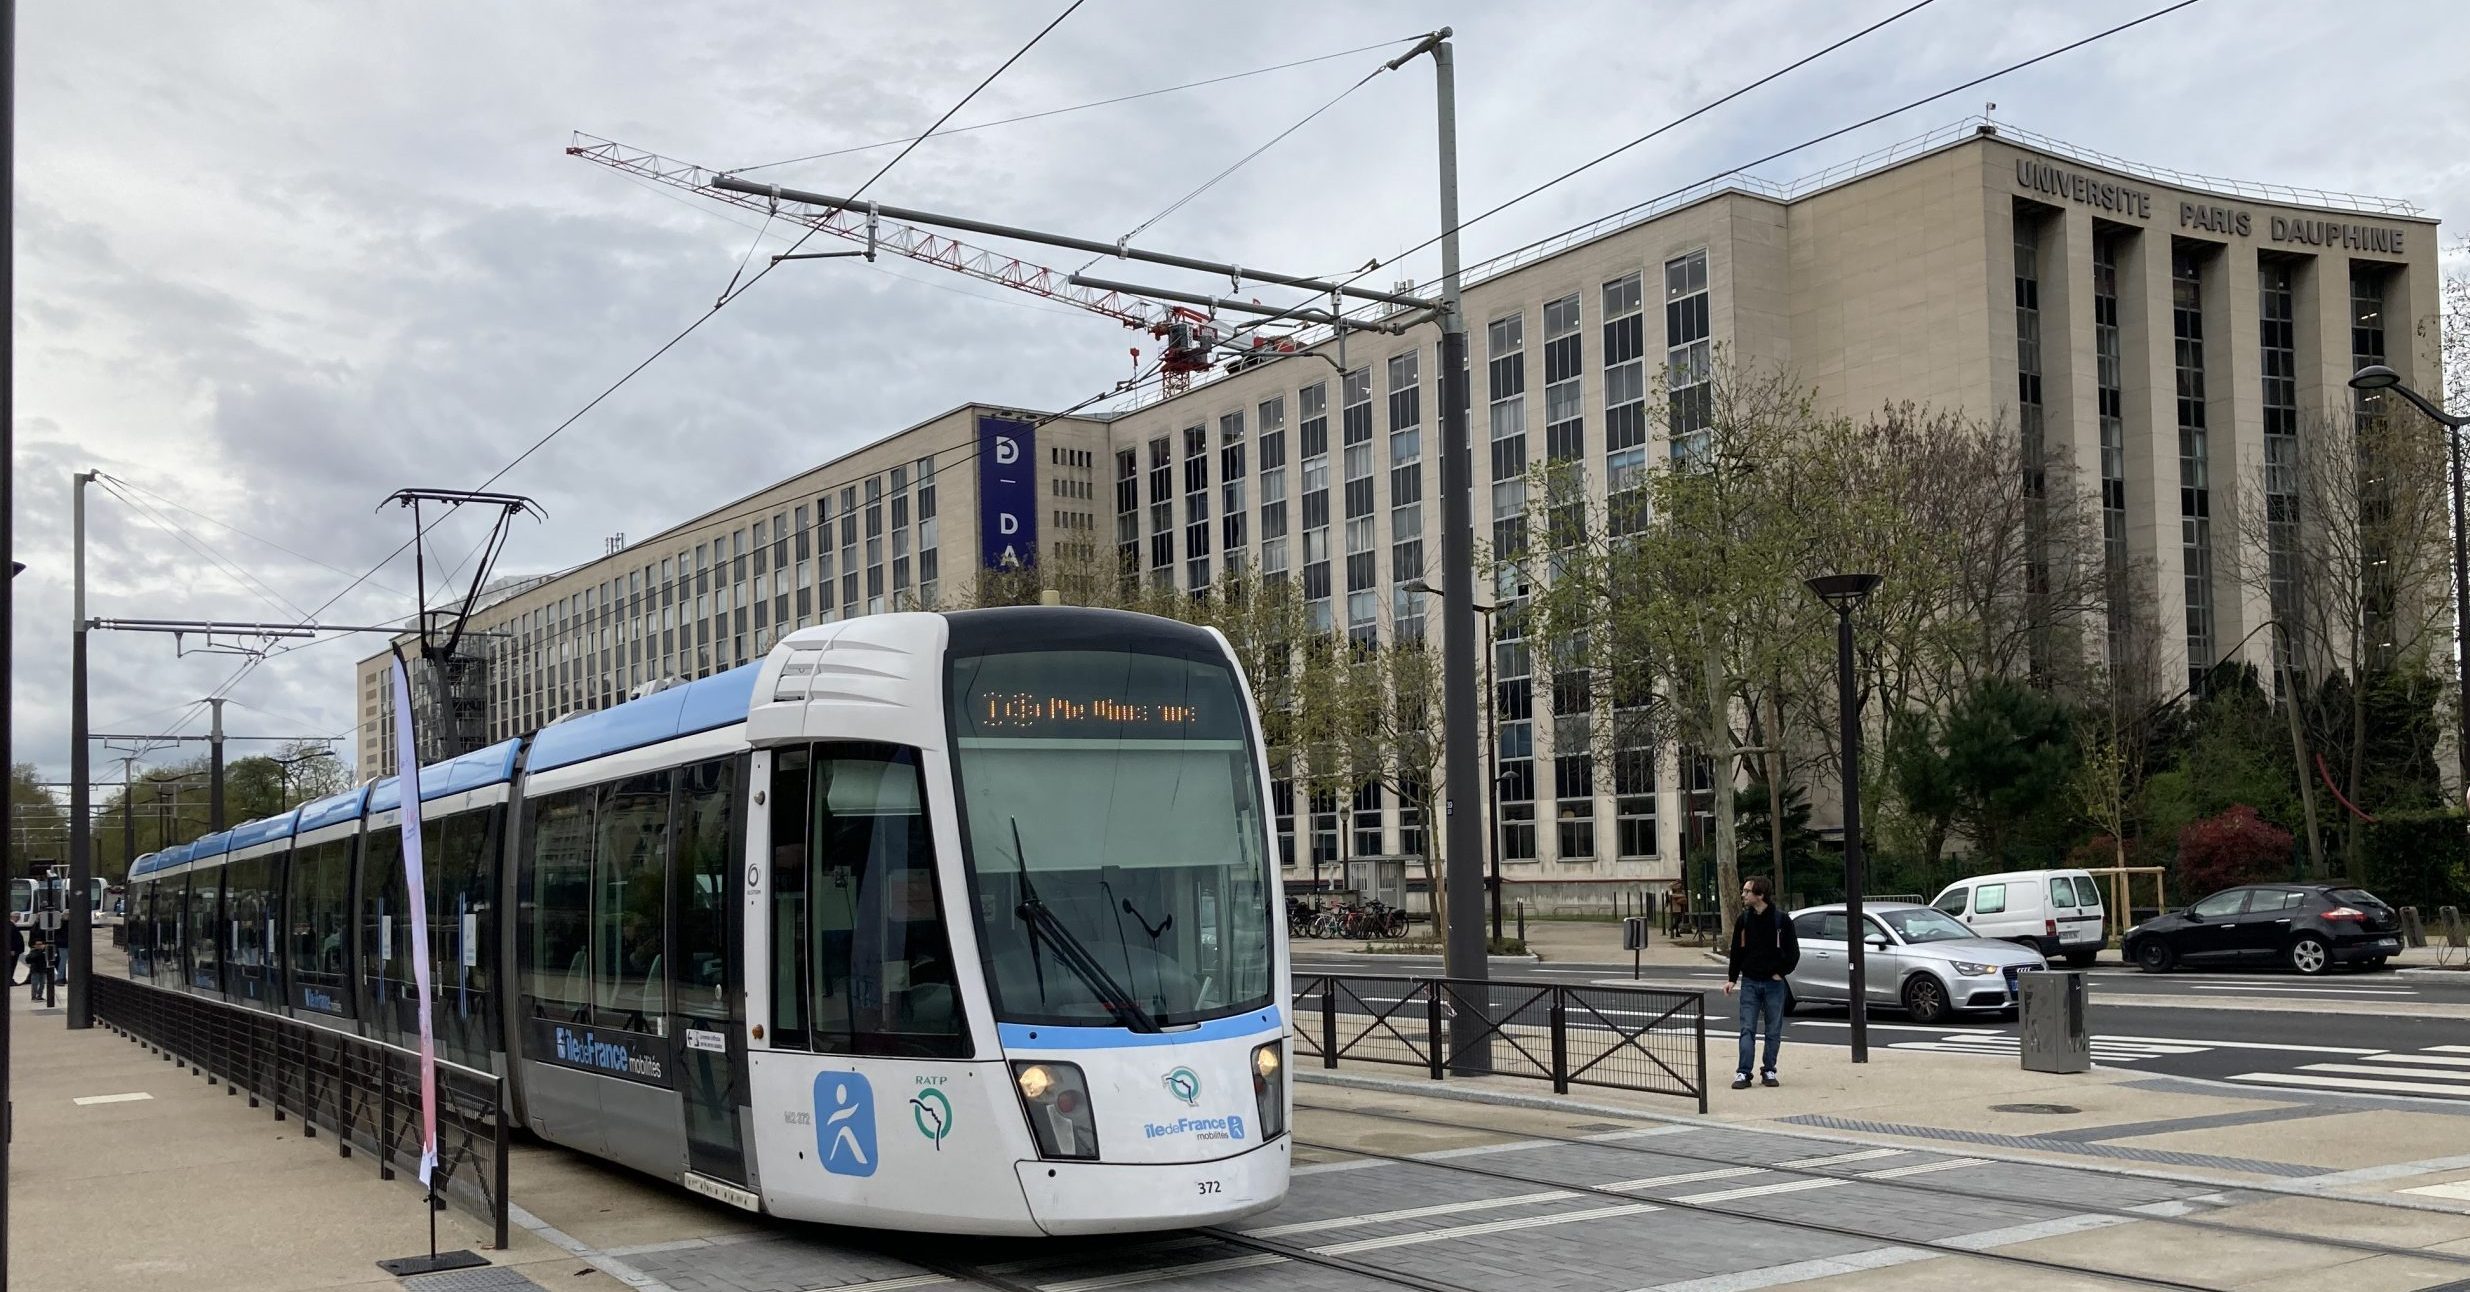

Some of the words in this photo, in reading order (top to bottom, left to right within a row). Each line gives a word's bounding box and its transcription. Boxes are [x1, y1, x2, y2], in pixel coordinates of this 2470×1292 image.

[2016, 159, 2151, 218] UNIVERSITE
[2180, 201, 2251, 237] PARIS
[2271, 216, 2404, 253] DAUPHINE
[915, 1075, 948, 1086] RATP
[1197, 1180, 1222, 1195] 372
